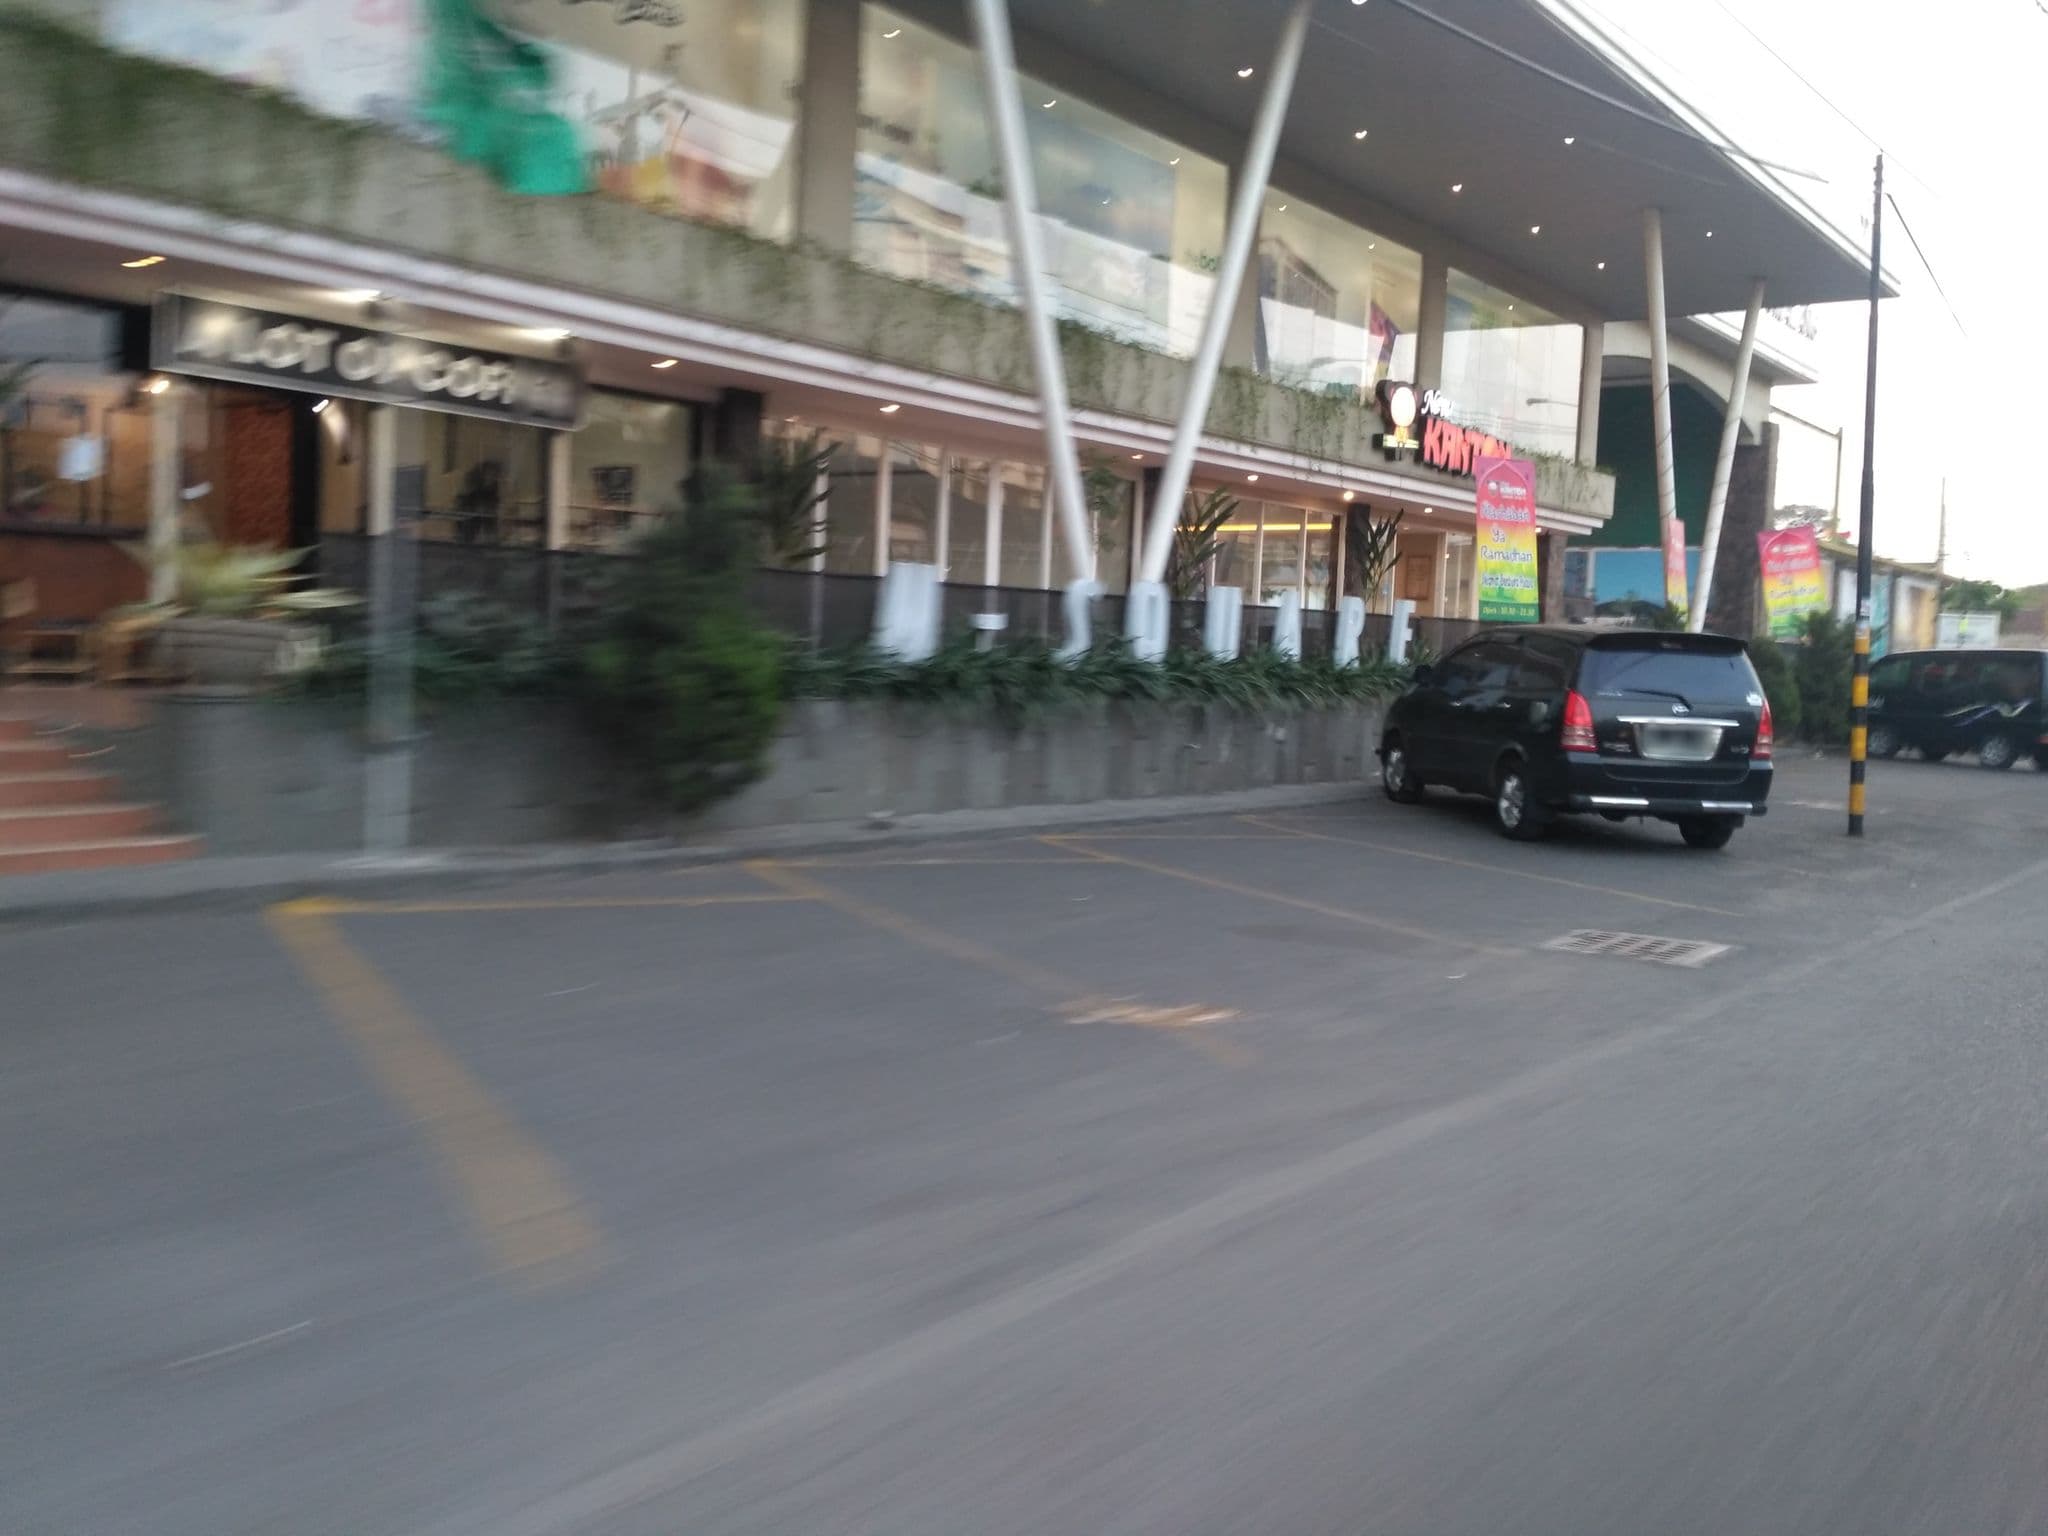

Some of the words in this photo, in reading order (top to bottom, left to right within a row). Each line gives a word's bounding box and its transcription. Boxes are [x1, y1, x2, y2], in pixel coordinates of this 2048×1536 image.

[229, 317, 340, 374] LOT
[411, 350, 574, 415] COFF
[1421, 389, 1456, 418] New
[1481, 545, 1533, 562] Ramadhan
